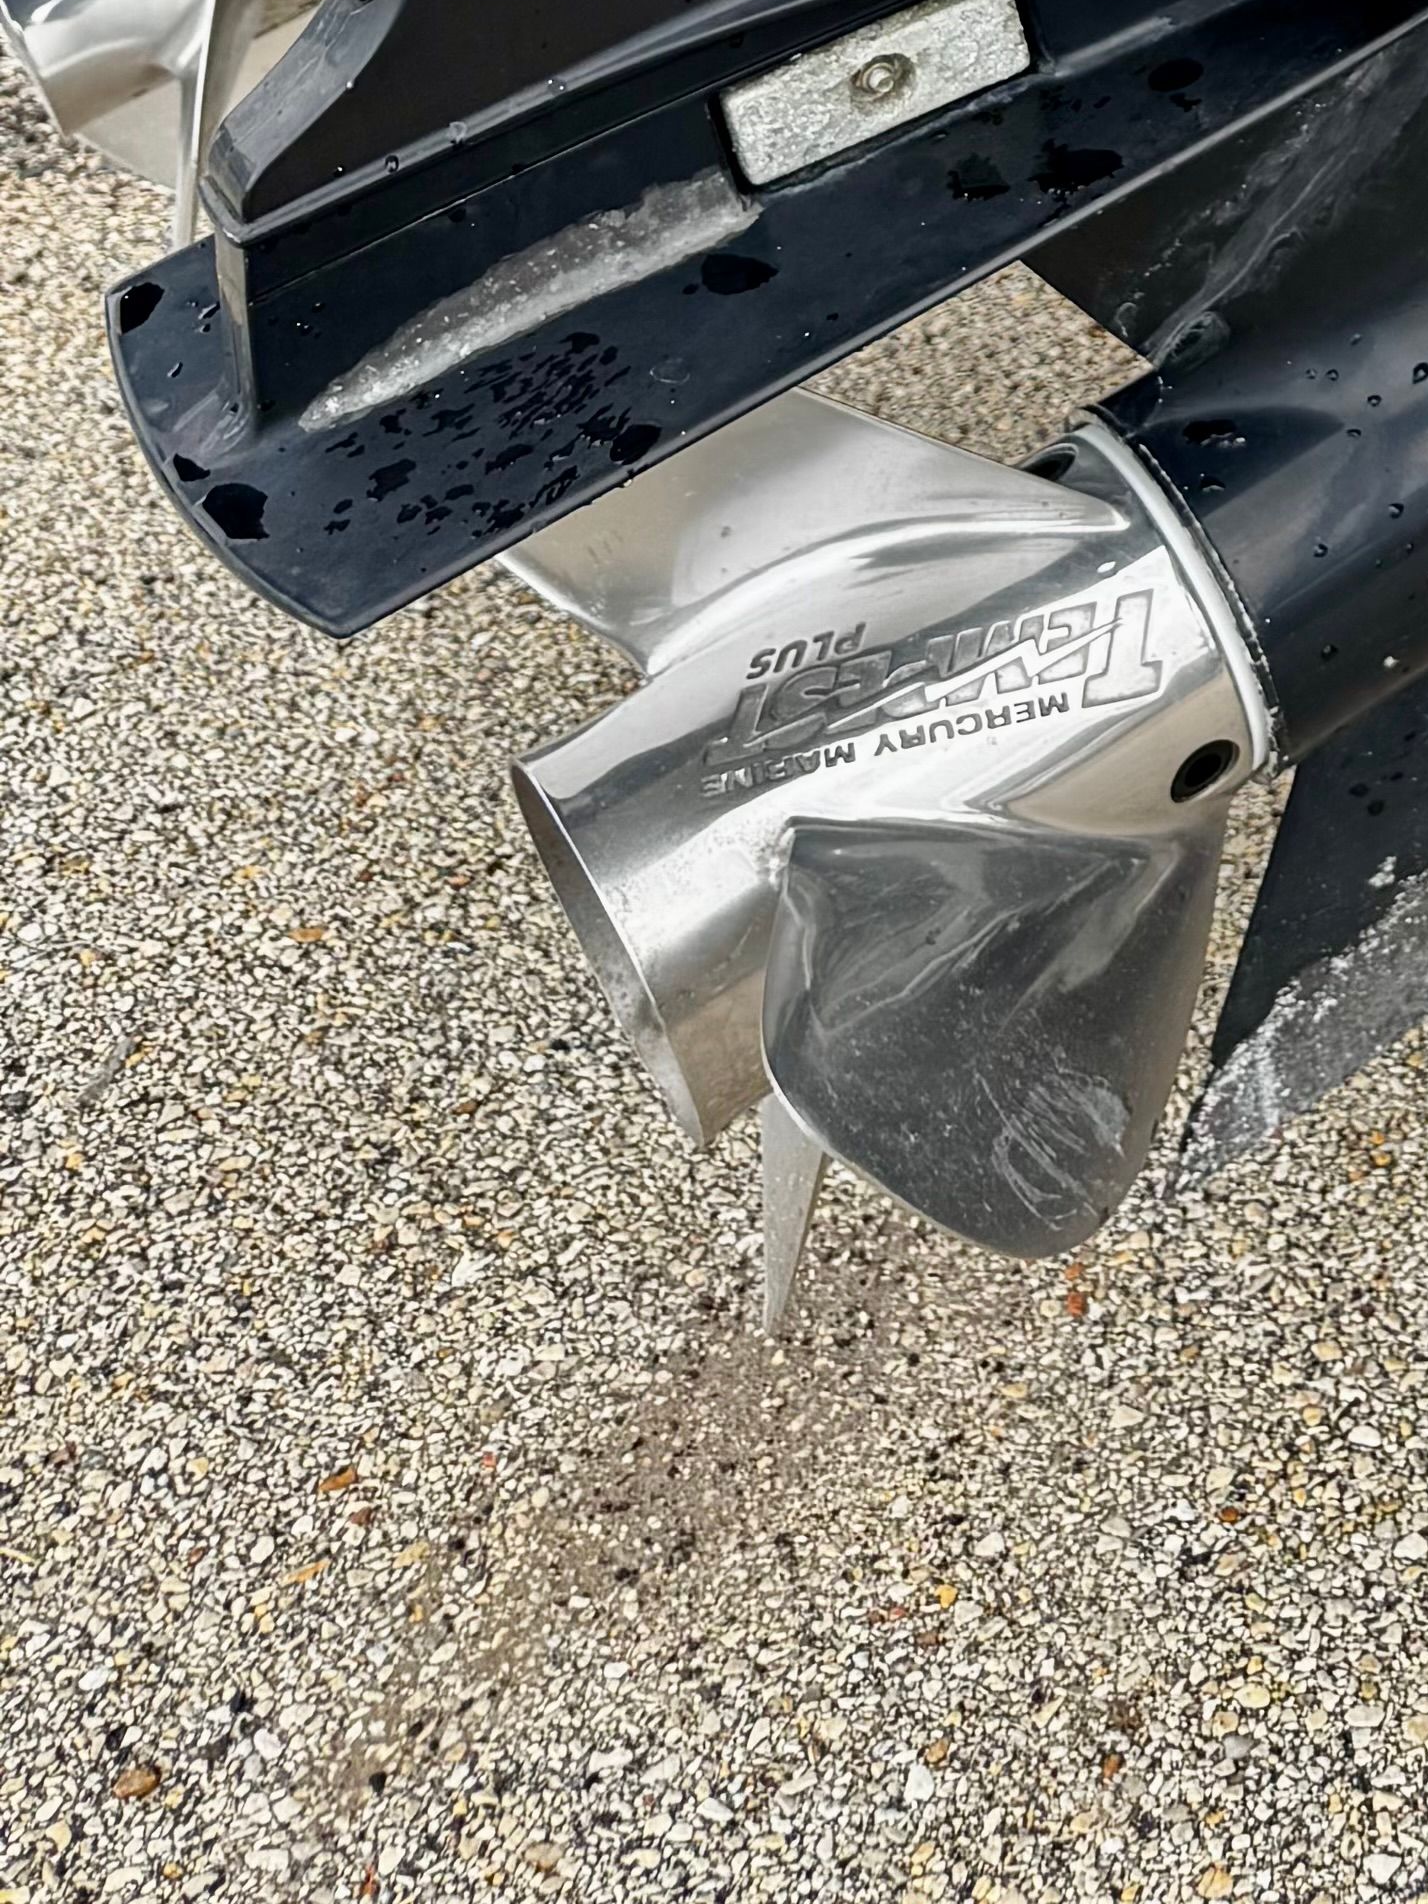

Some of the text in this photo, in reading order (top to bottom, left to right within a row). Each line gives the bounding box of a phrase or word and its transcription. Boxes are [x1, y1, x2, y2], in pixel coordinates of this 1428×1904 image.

[746, 622, 867, 680] PLUS
[702, 691, 1070, 792] MERCURY MARINE
